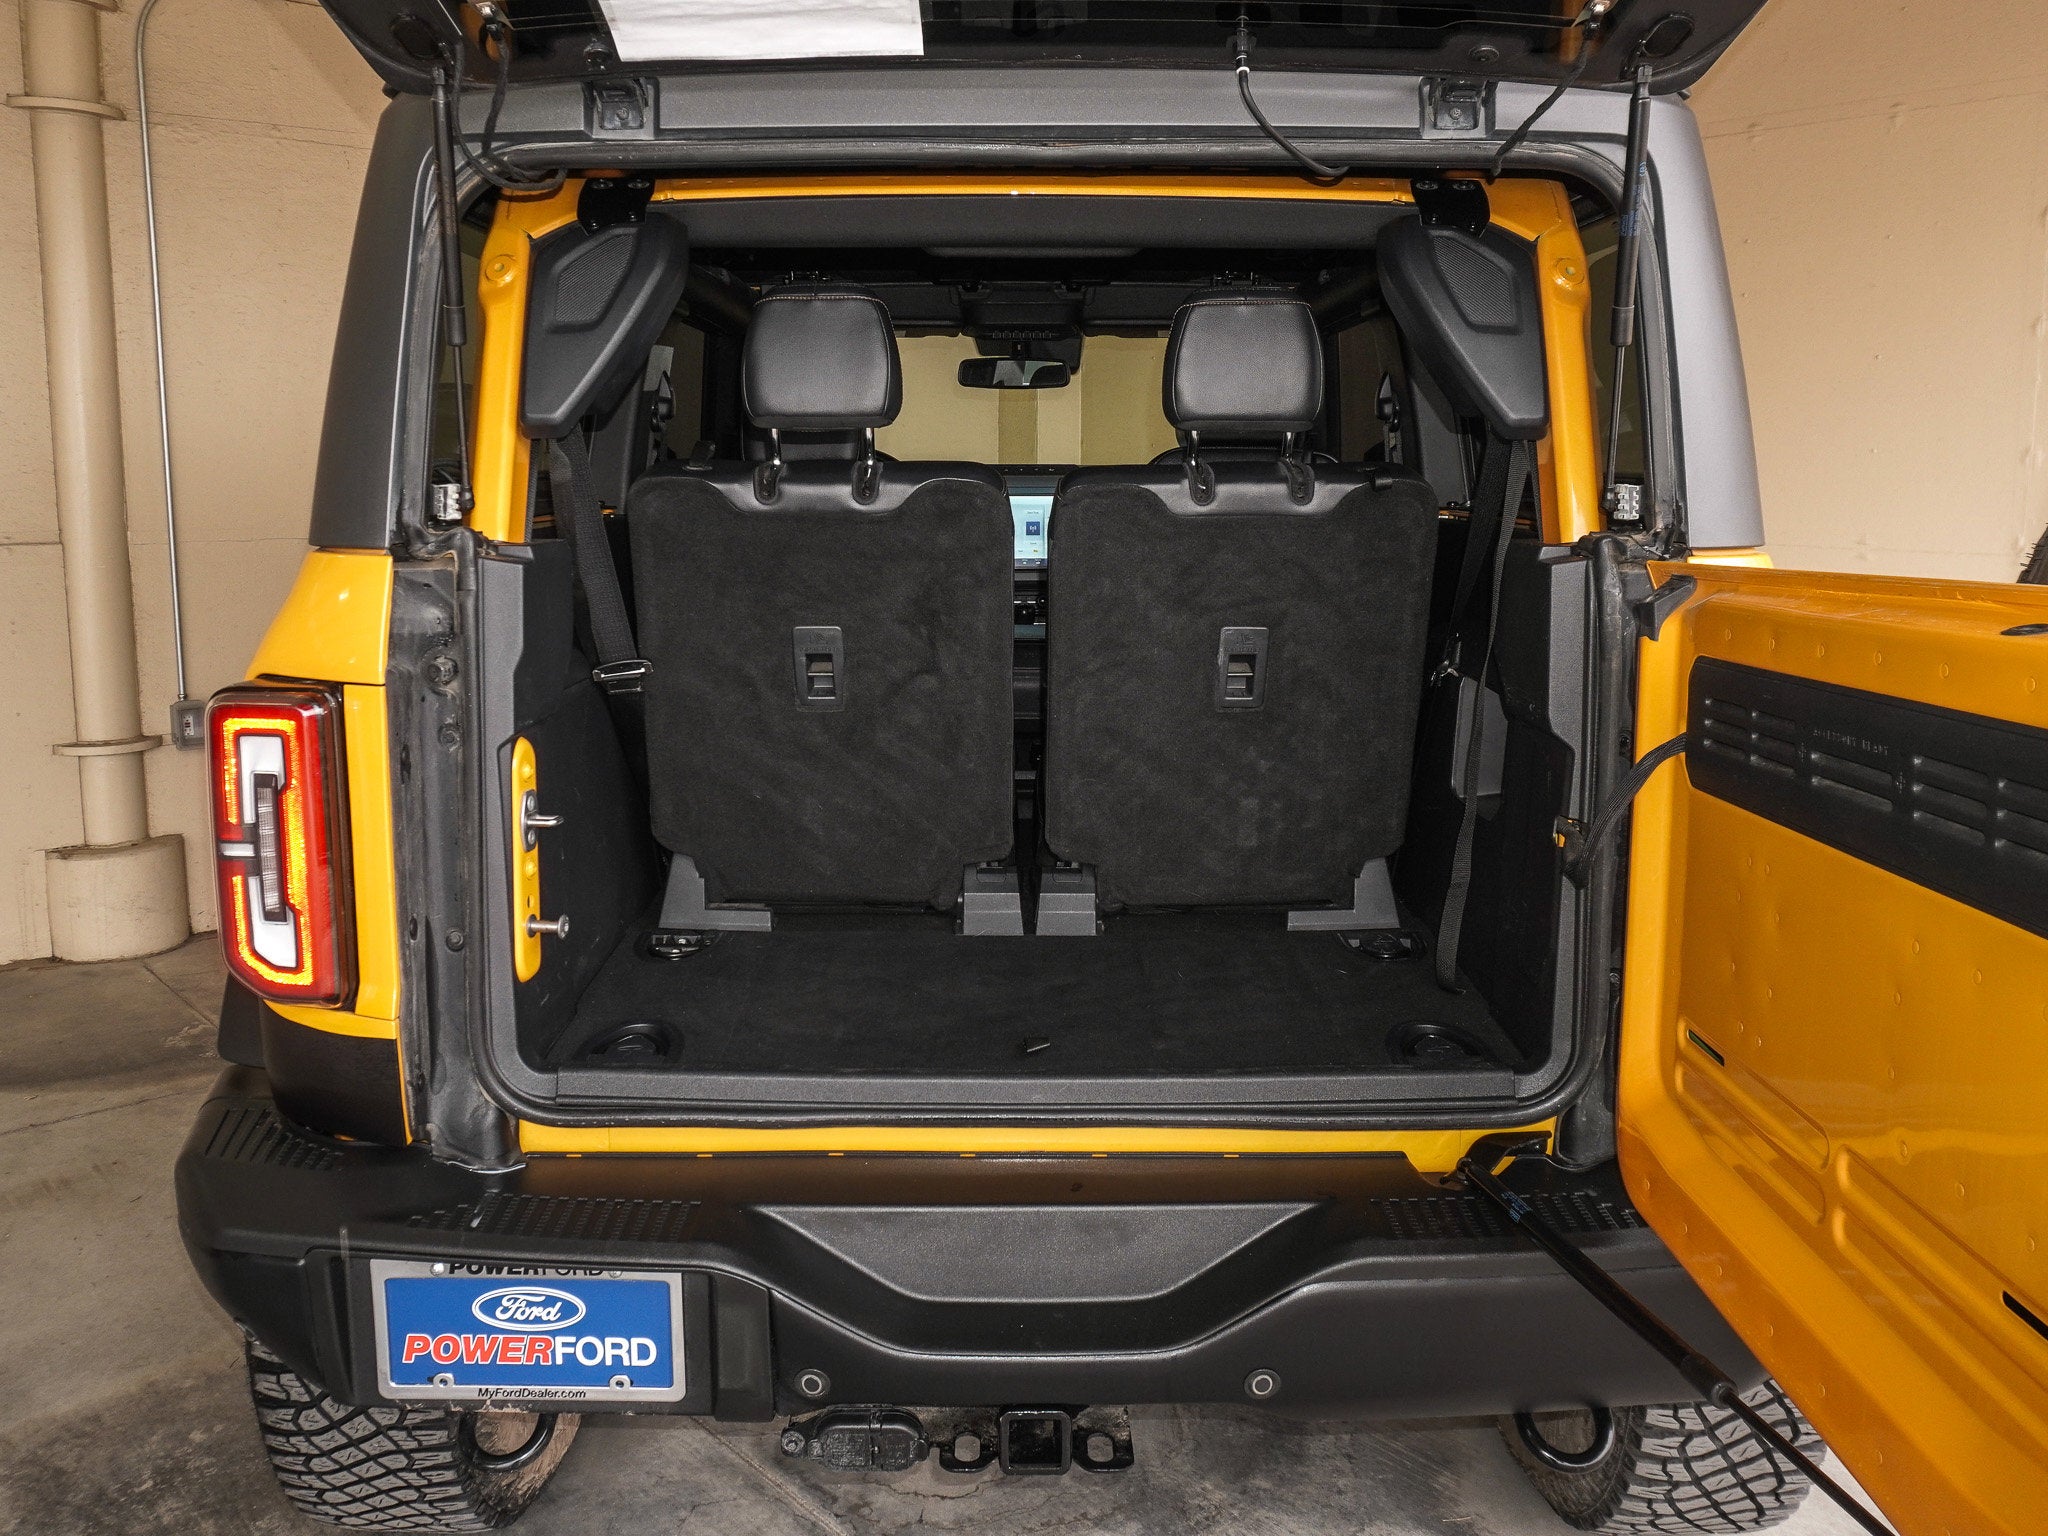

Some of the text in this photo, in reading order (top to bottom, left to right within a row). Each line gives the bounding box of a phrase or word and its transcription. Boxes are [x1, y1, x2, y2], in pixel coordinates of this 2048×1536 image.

[495, 1292, 562, 1321] Ford
[402, 1333, 657, 1366] POWERFORD
[477, 1387, 586, 1400] MyFordDealer.com
